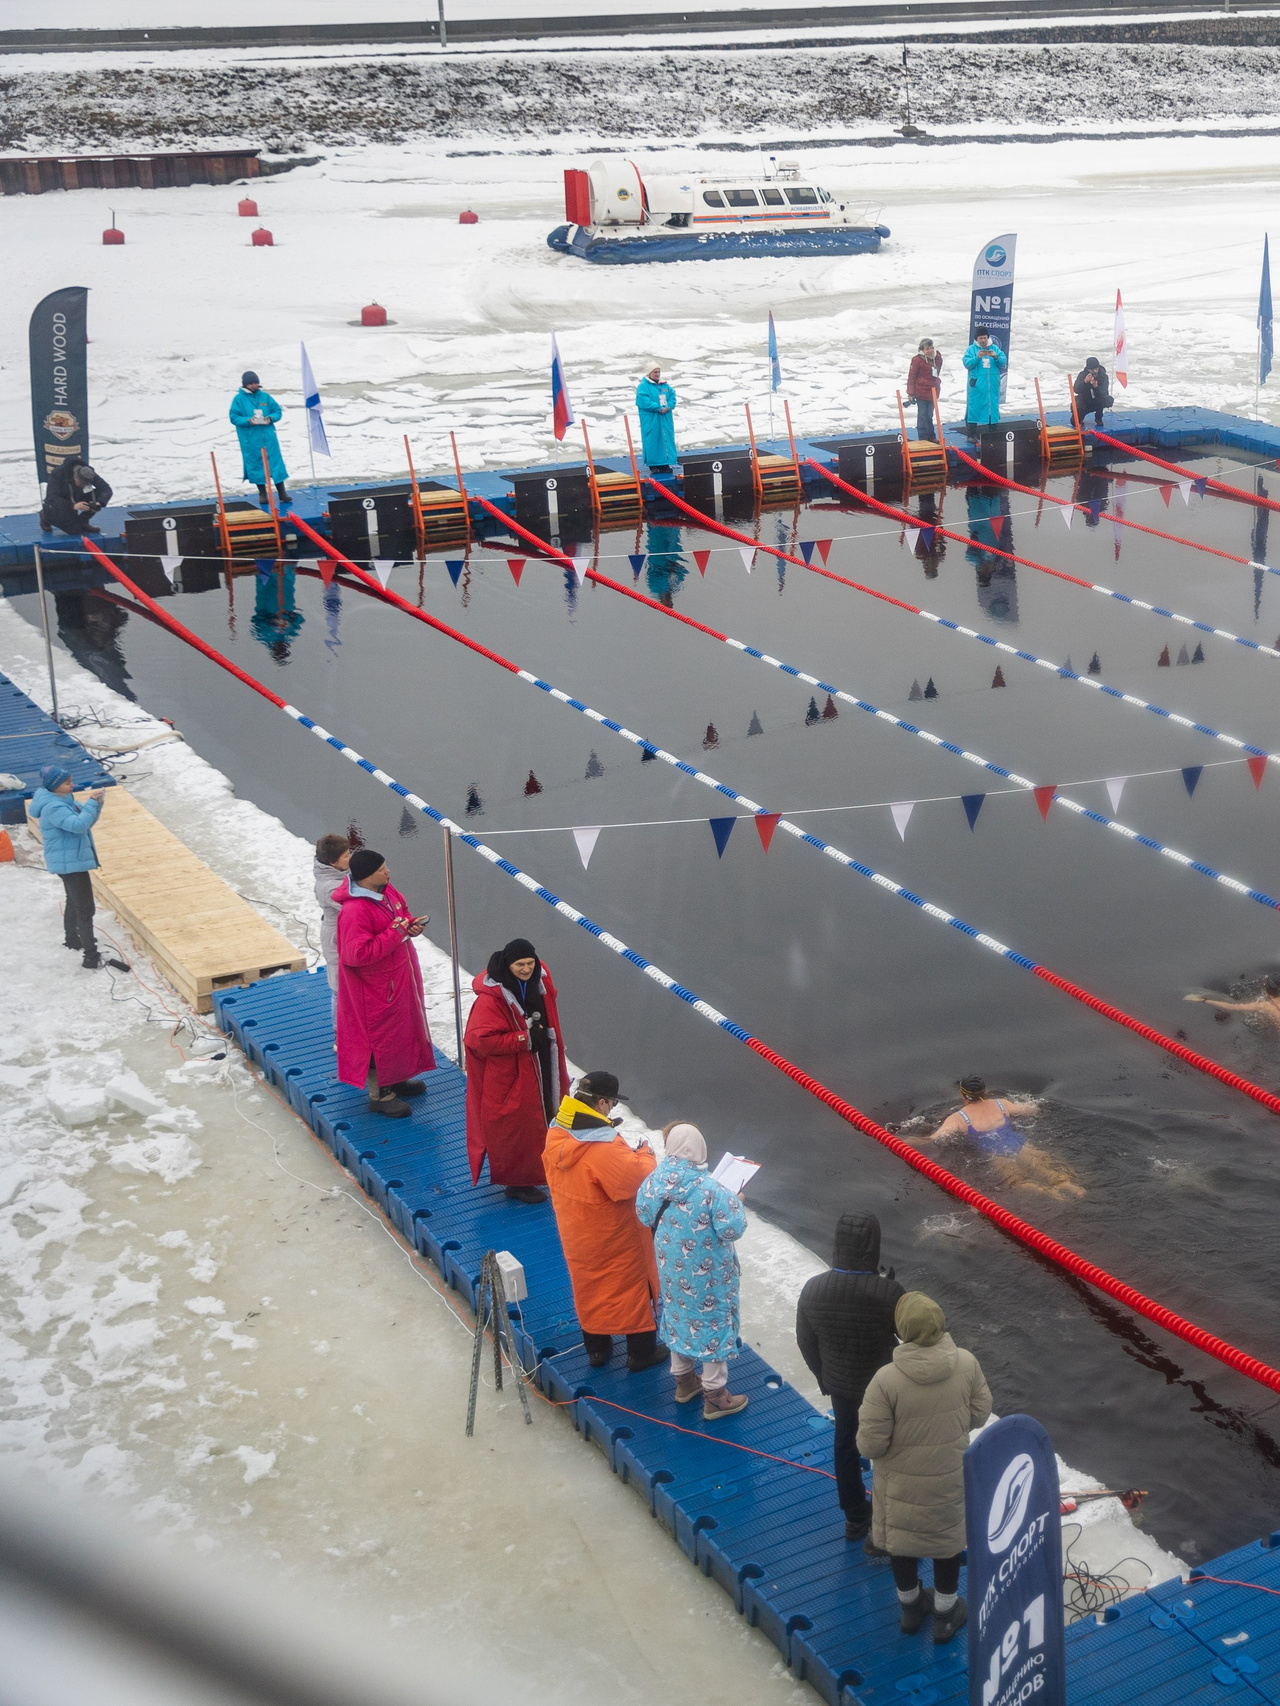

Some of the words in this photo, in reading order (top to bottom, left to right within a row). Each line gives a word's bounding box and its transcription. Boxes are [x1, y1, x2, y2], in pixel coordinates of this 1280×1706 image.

[991, 269, 1013, 277] СПОРТ
[974, 321, 1010, 329] БАССЕЙНОВ
[53, 312, 67, 362] WOOD
[53, 366, 68, 406] HARD
[1007, 432, 1013, 441] 6
[867, 446, 873, 454] 5
[713, 463, 720, 471] 4
[549, 480, 555, 488] 3
[366, 499, 372, 508] 2
[165, 520, 172, 528] 1
[999, 1511, 1050, 1582] СПОРТ
